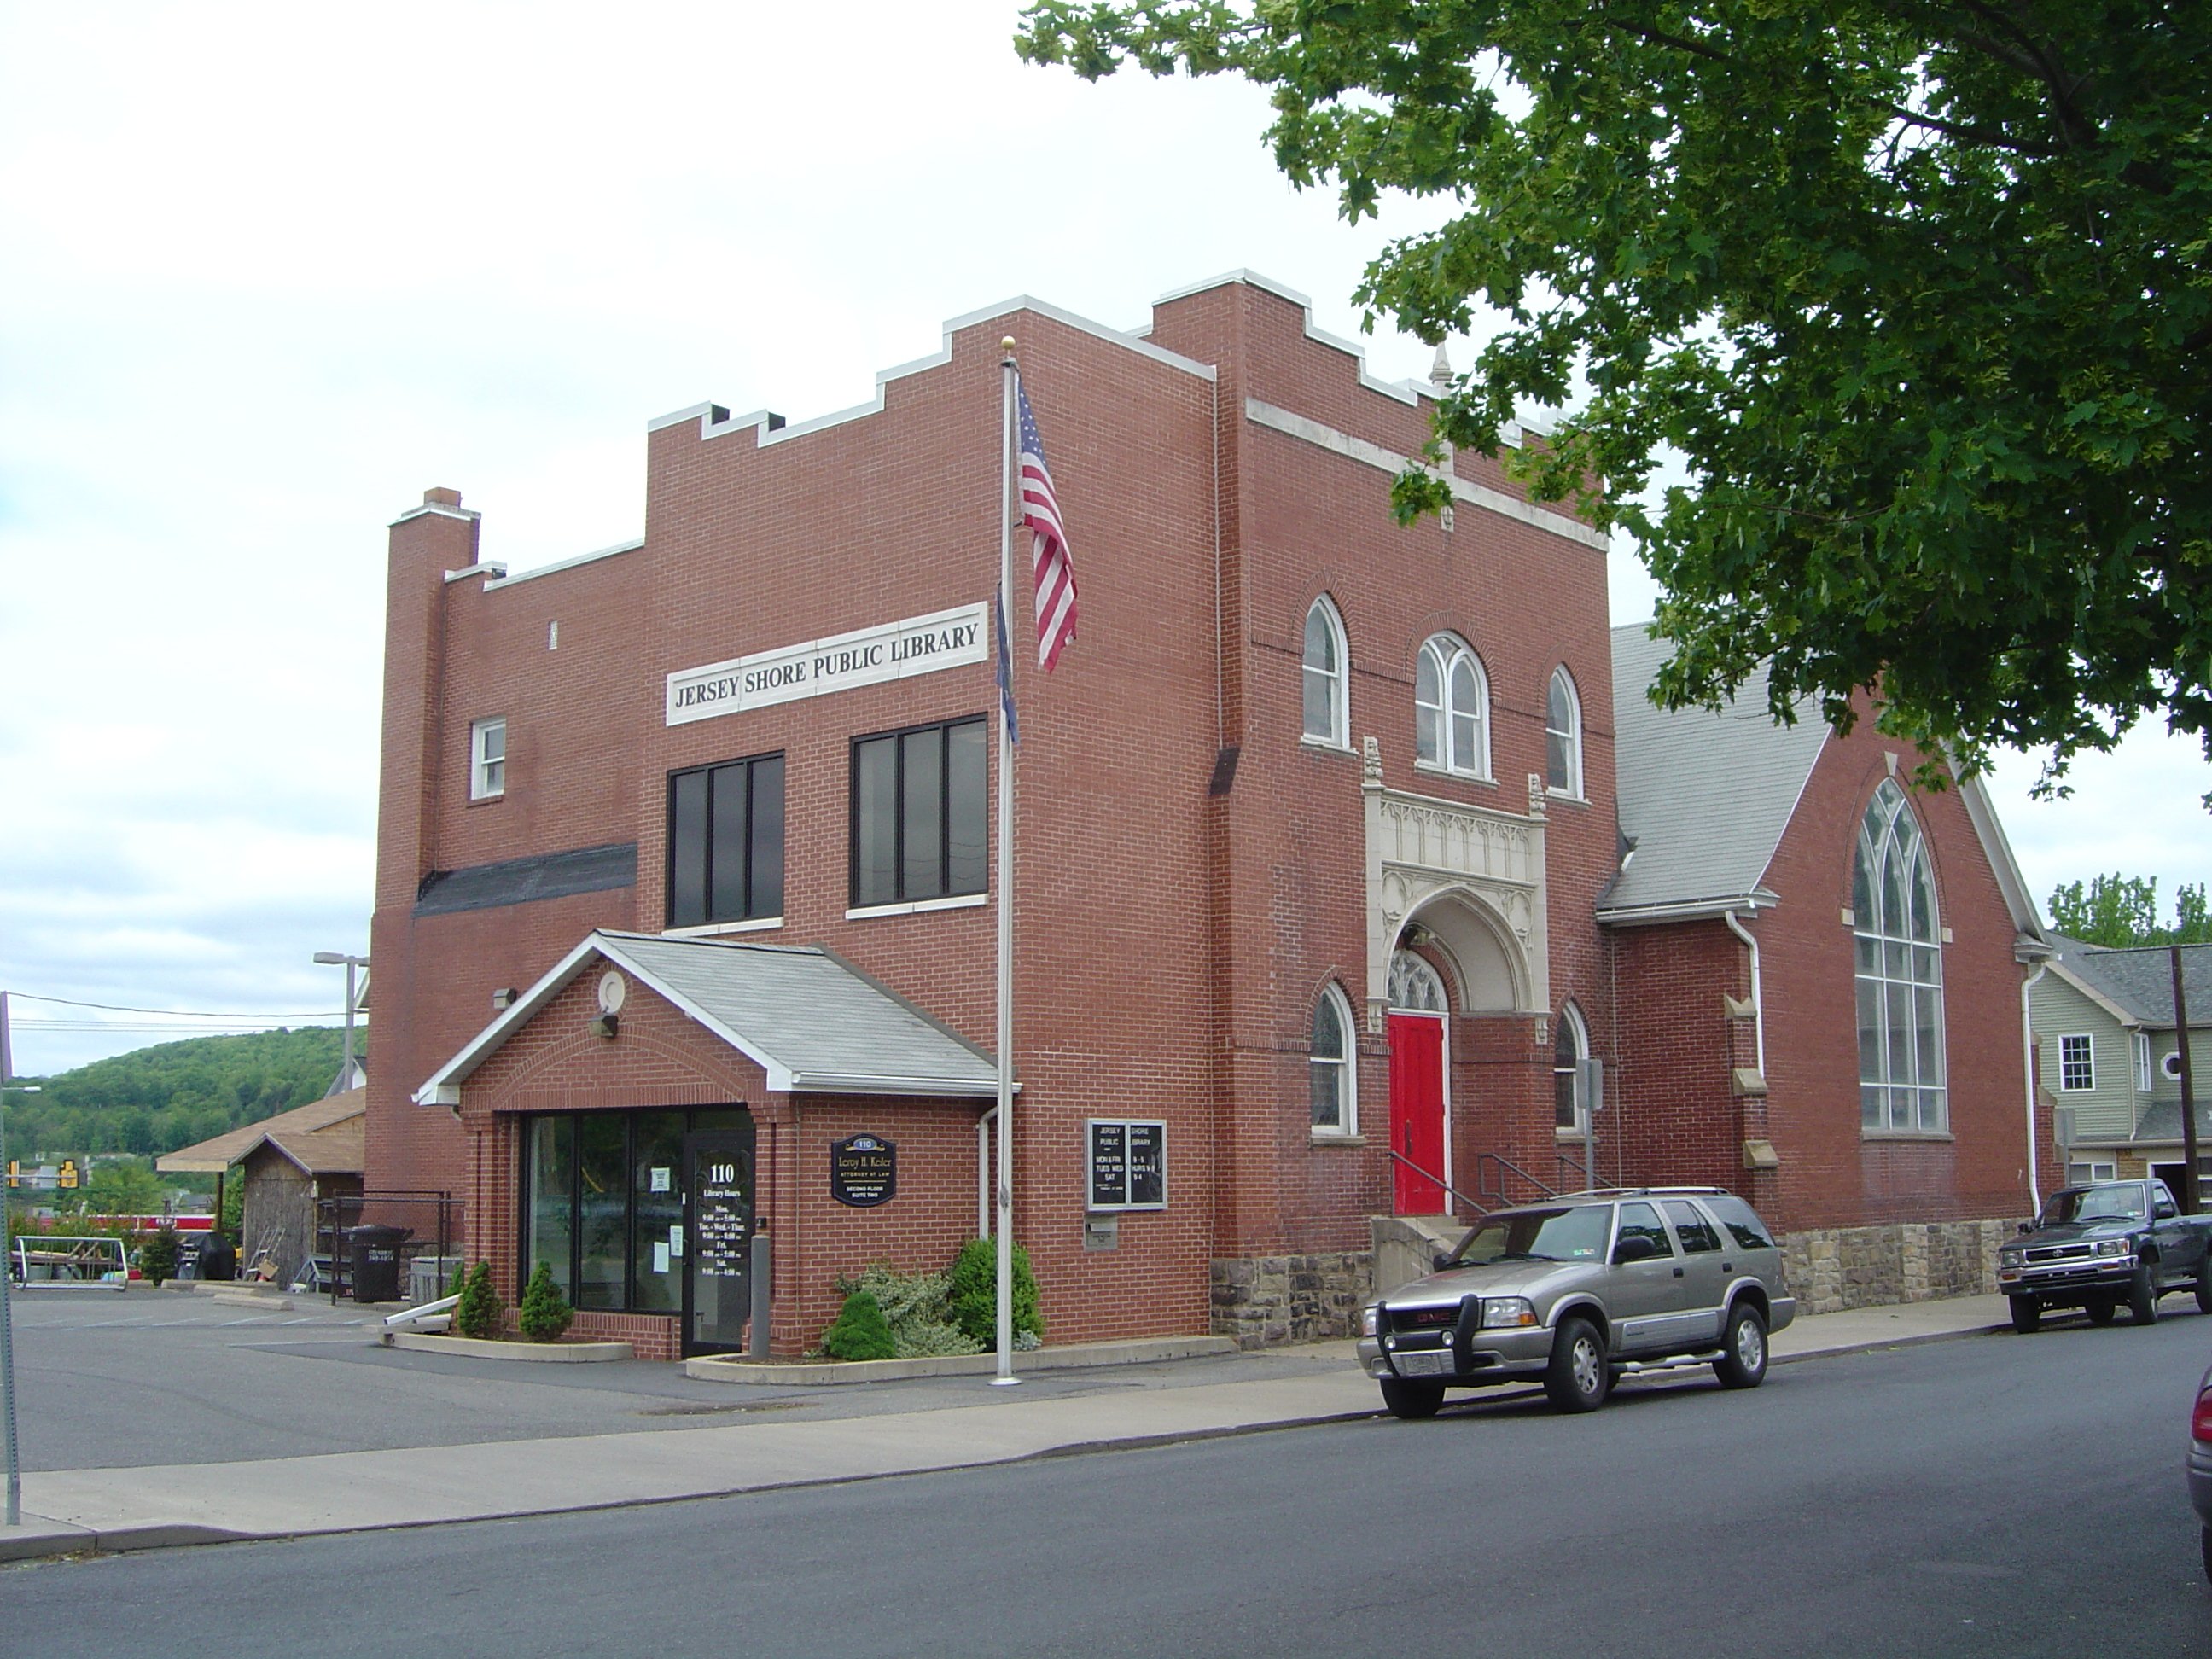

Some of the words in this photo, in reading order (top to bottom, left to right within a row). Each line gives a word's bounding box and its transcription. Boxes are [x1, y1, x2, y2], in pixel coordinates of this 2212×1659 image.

[675, 676, 740, 708] JERSEY
[744, 661, 806, 693] SHORE
[813, 644, 883, 678] PUBLIC
[890, 623, 979, 661] LIBRARY
[838, 1156, 859, 1170] Leroy
[710, 1164, 734, 1183] 110
[703, 1189, 724, 1198] Library
[1417, 1312, 1451, 1323] GMC
